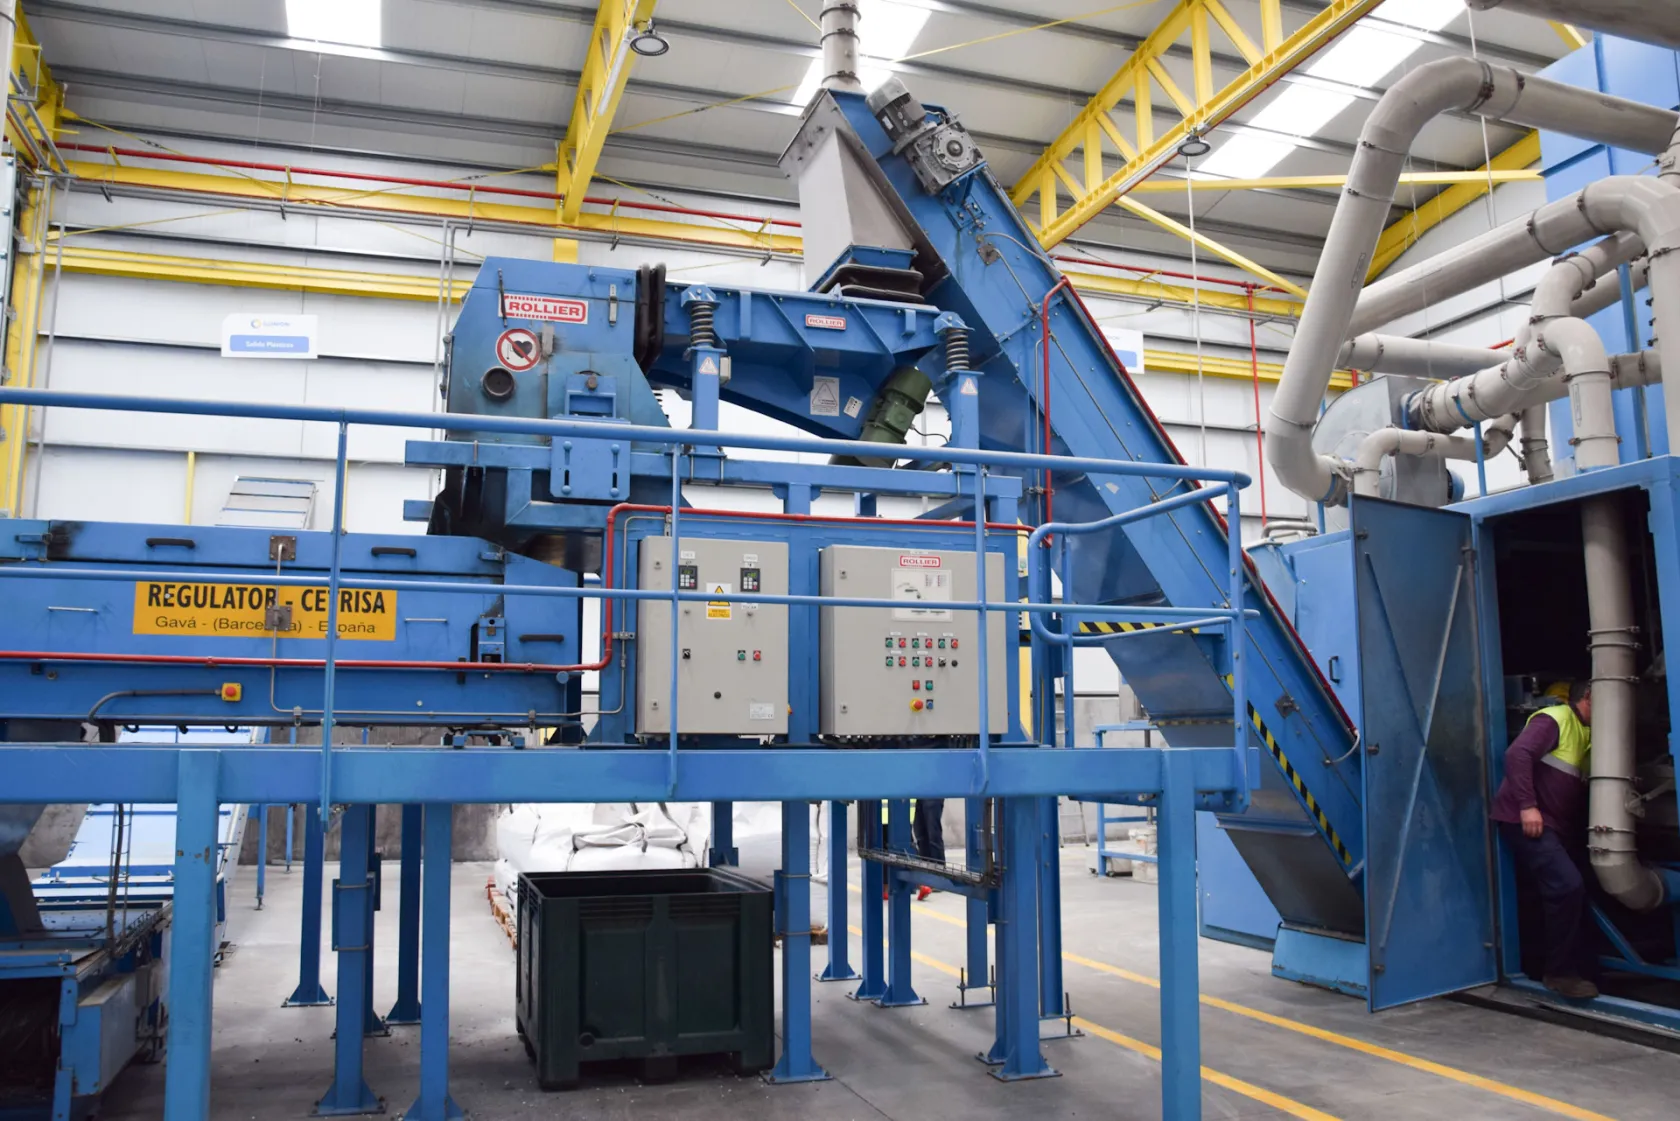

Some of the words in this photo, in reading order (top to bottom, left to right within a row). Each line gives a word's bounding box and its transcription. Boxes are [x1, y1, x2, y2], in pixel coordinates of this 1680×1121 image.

[508, 301, 580, 316] ROLLIER
[148, 584, 277, 610] REGULATOR
[301, 589, 385, 613] CERISA
[155, 615, 197, 628] Gavá
[213, 617, 302, 633] (Barcea)
[318, 620, 376, 633] Epaña
